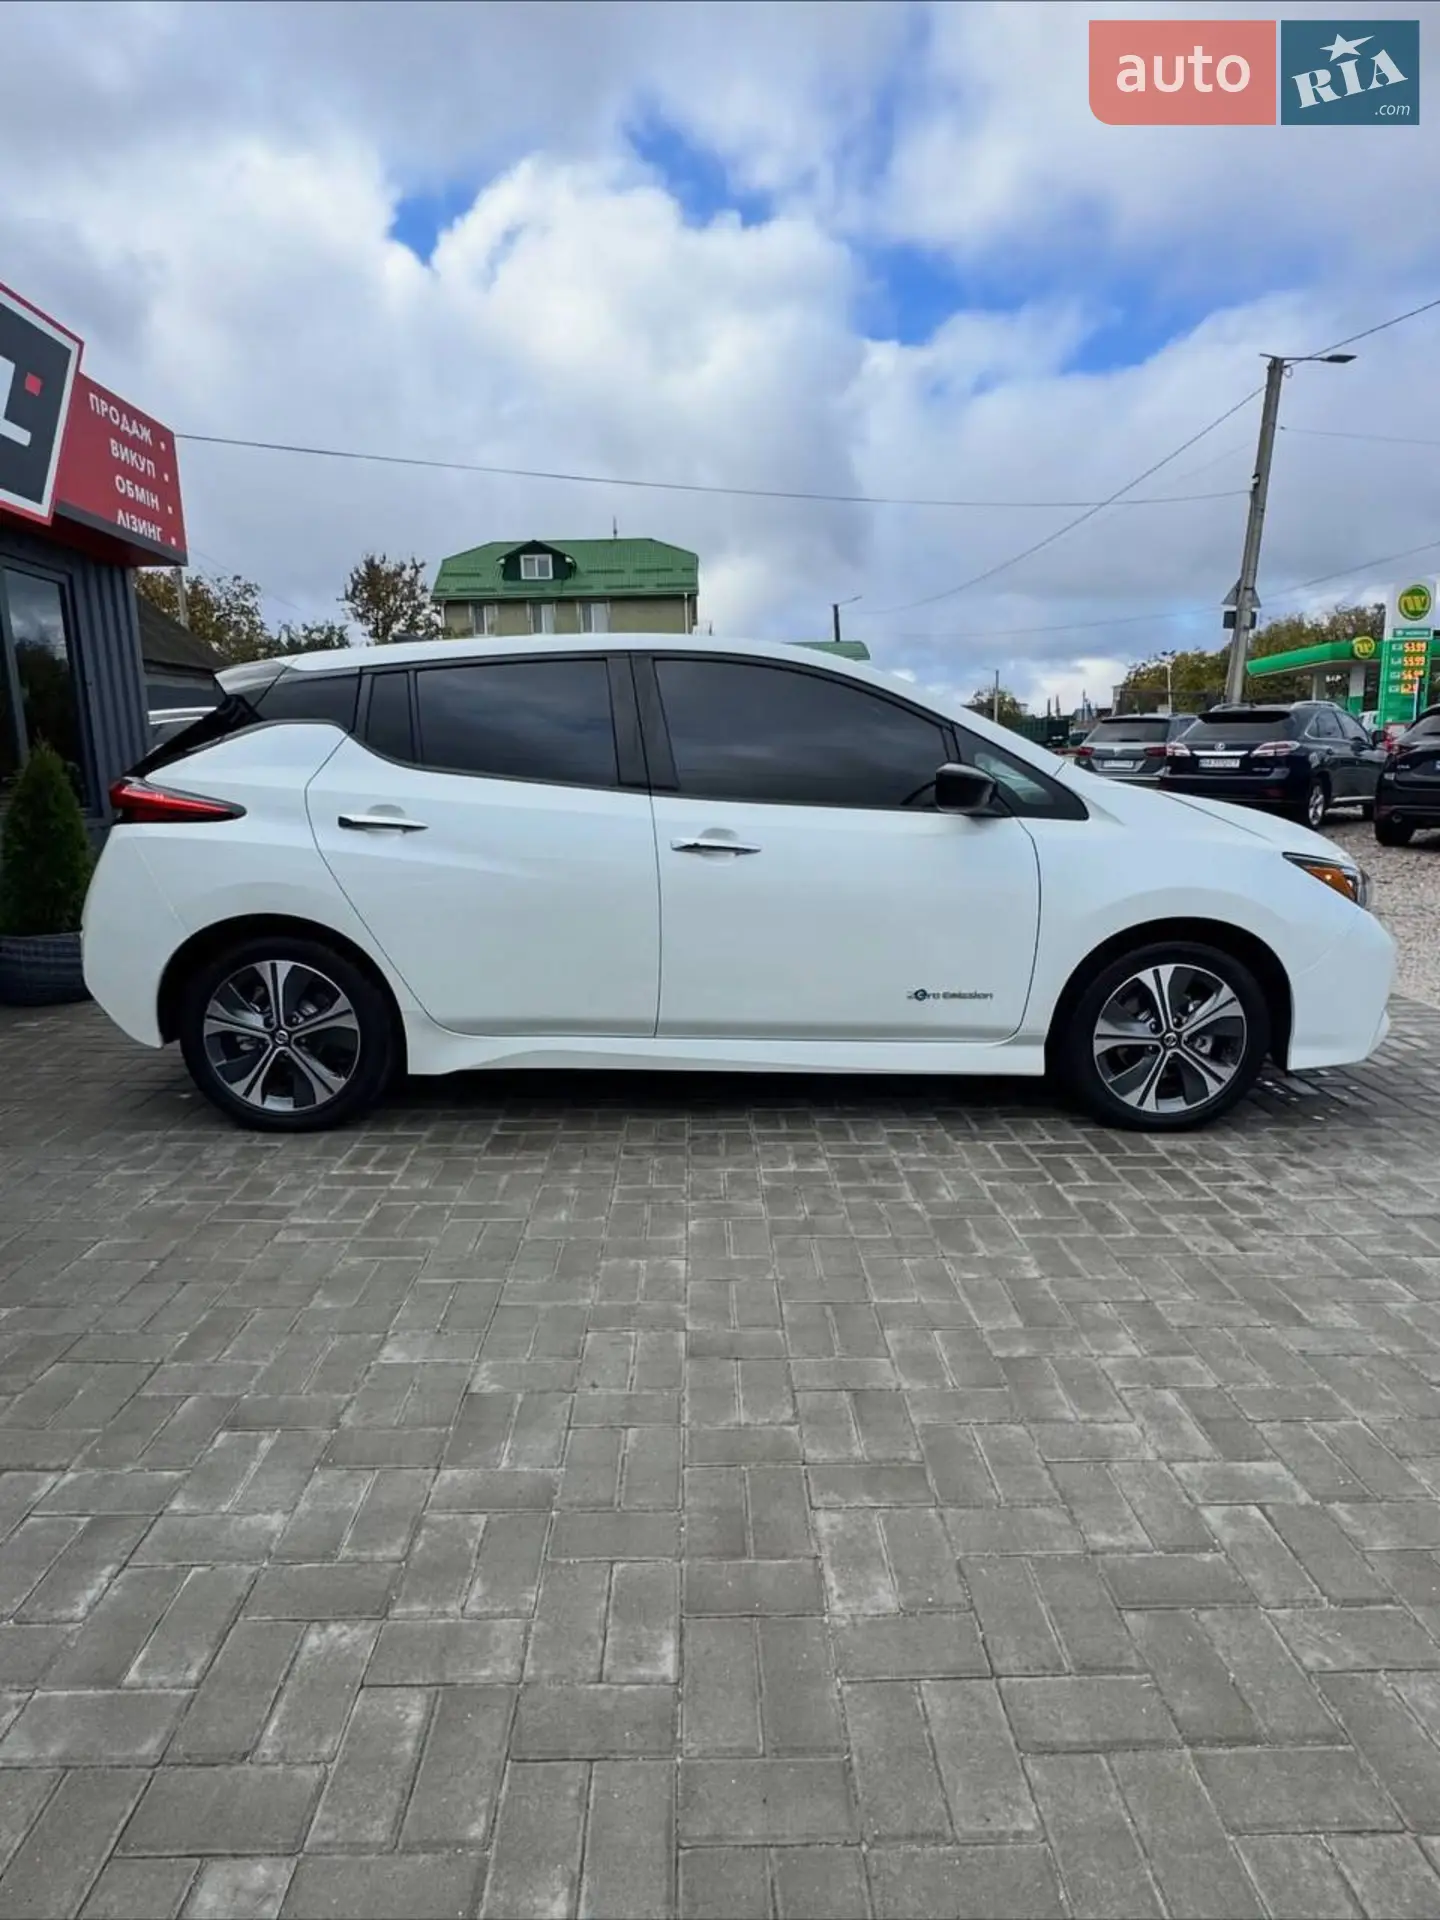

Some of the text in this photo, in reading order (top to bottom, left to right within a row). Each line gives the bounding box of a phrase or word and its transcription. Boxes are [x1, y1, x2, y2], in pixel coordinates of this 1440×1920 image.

[88, 392, 153, 446] ПРОДАЖ
[109, 438, 156, 479] ВИКУП
[114, 475, 159, 512] ОБМІН
[116, 508, 163, 543] ЛІЗИНГ
